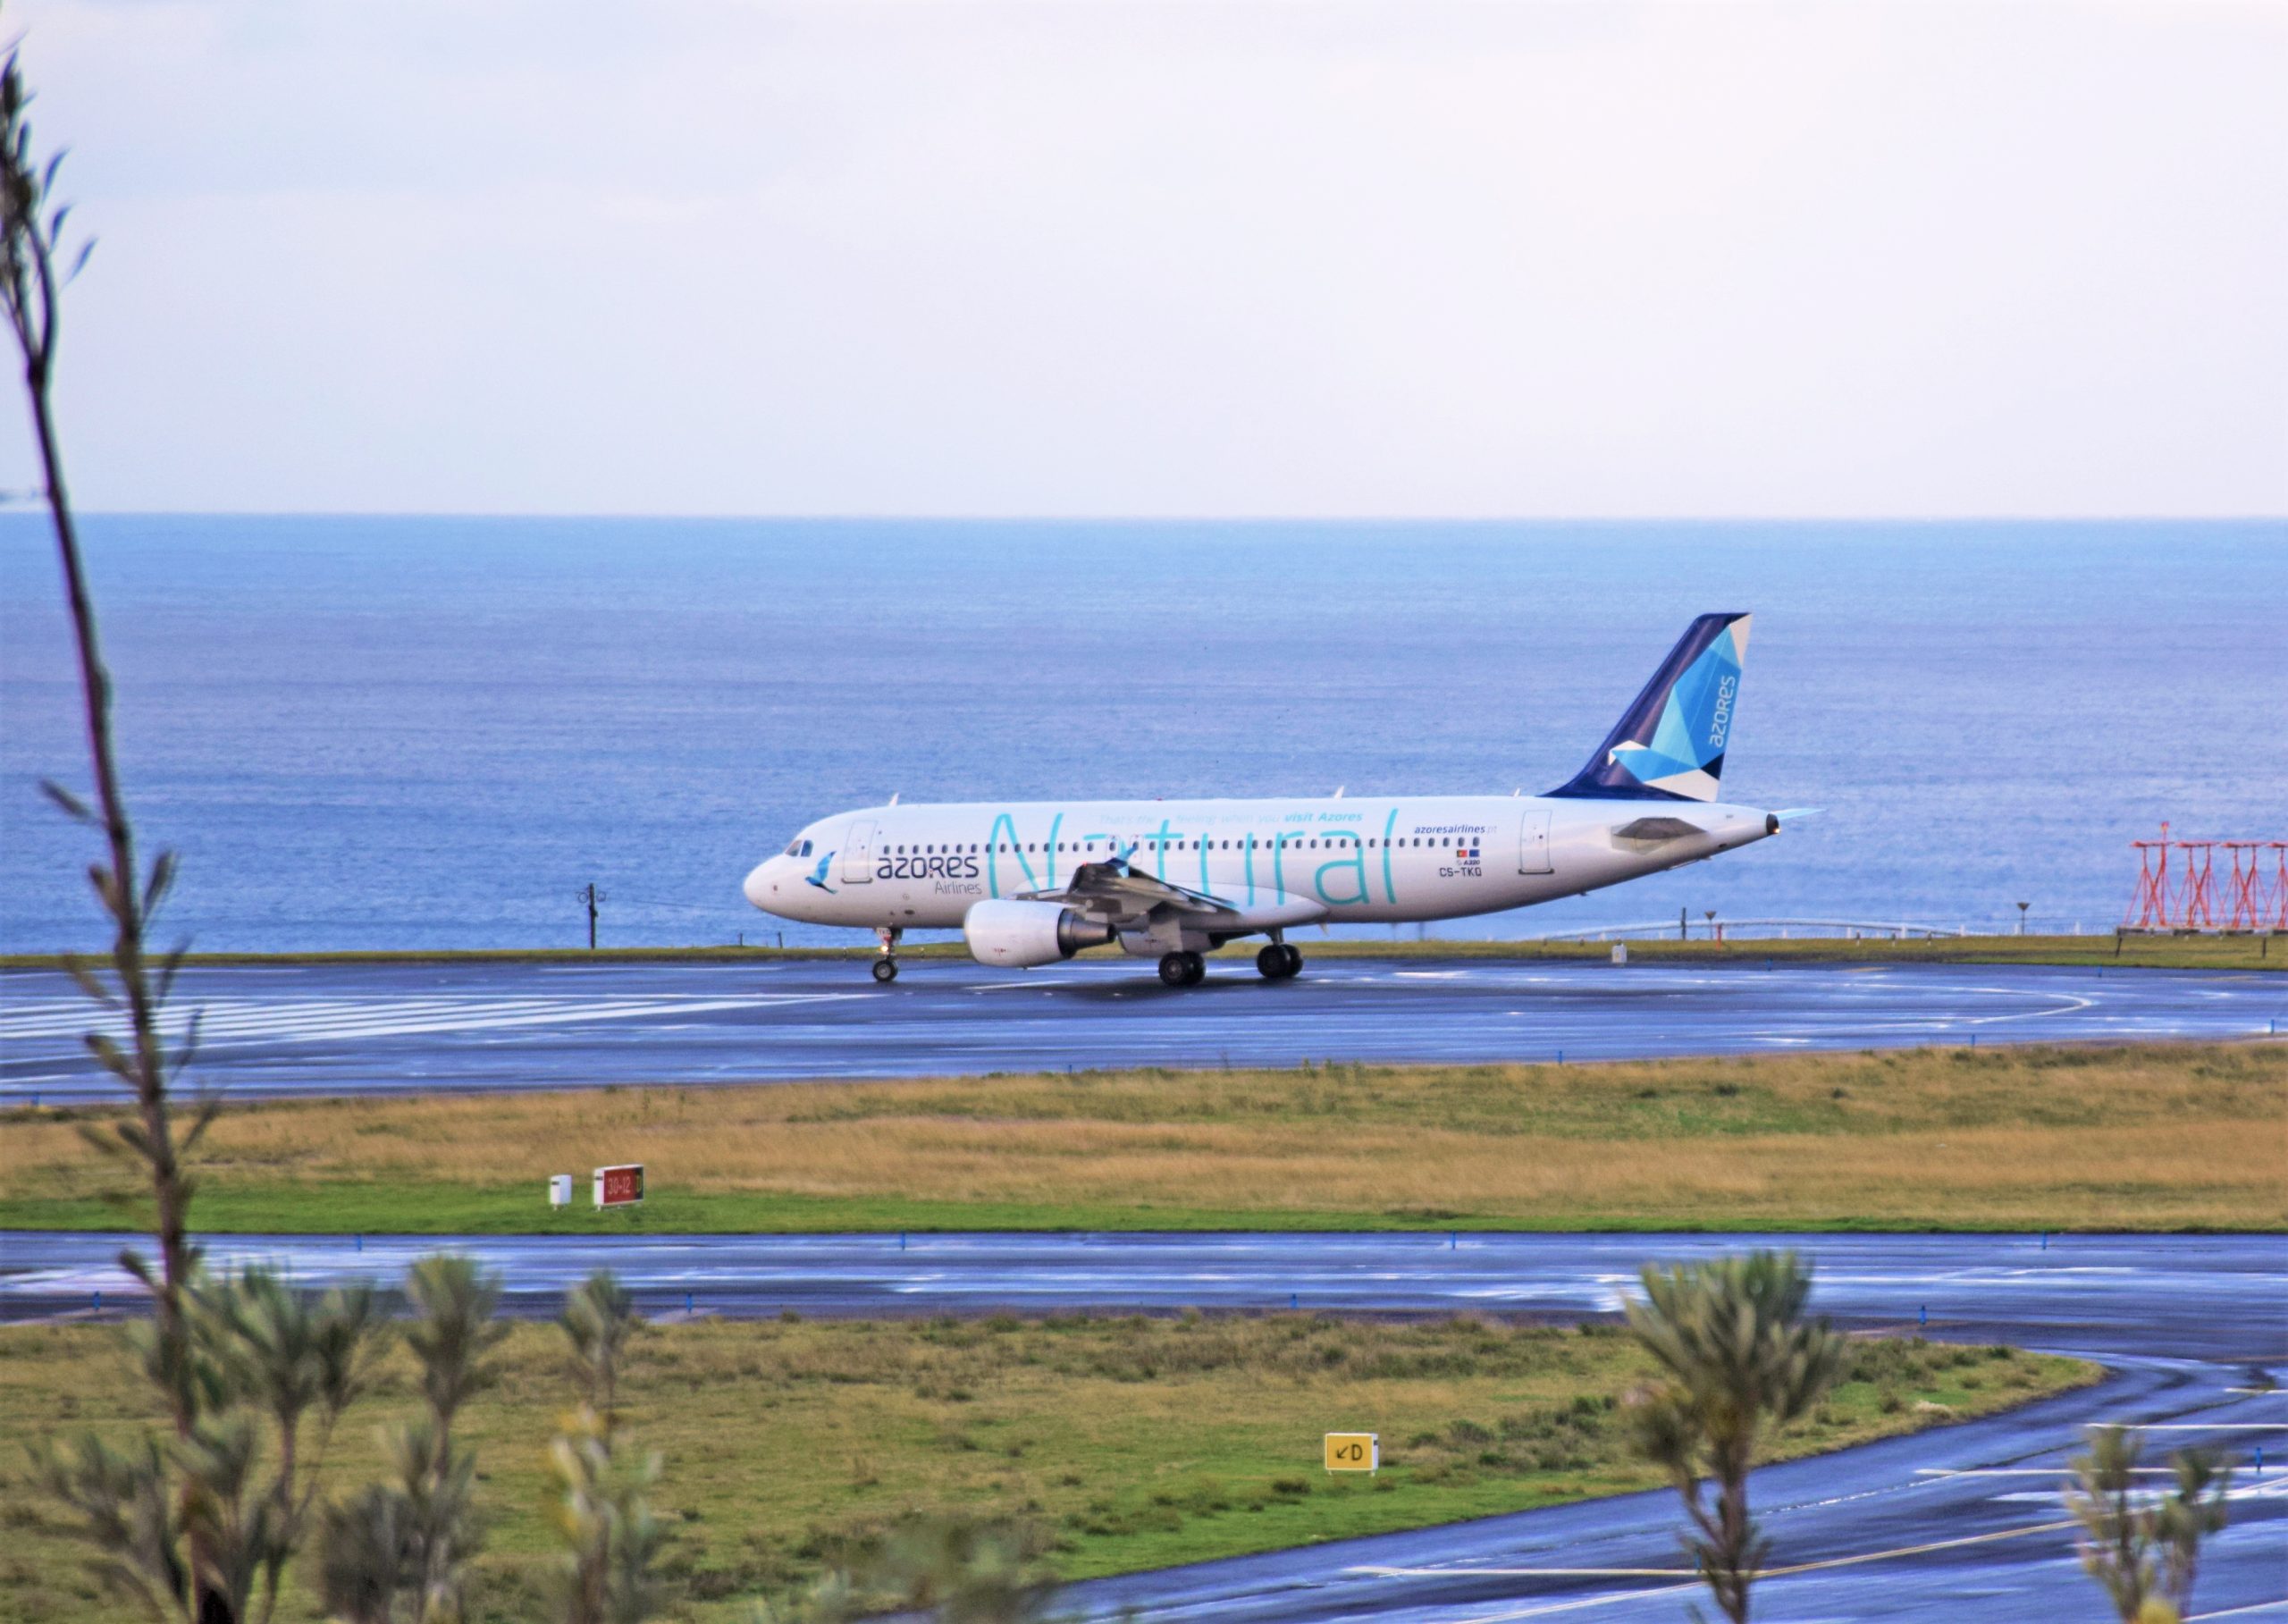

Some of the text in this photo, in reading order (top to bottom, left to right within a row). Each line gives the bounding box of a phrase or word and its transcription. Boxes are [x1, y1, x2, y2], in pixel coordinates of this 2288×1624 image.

[1284, 812, 1313, 822] visit
[1318, 812, 1363, 822] Azores
[988, 808, 1399, 907] Ntural
[935, 881, 982, 895] Airlines
[1351, 1443, 1363, 1461] D
